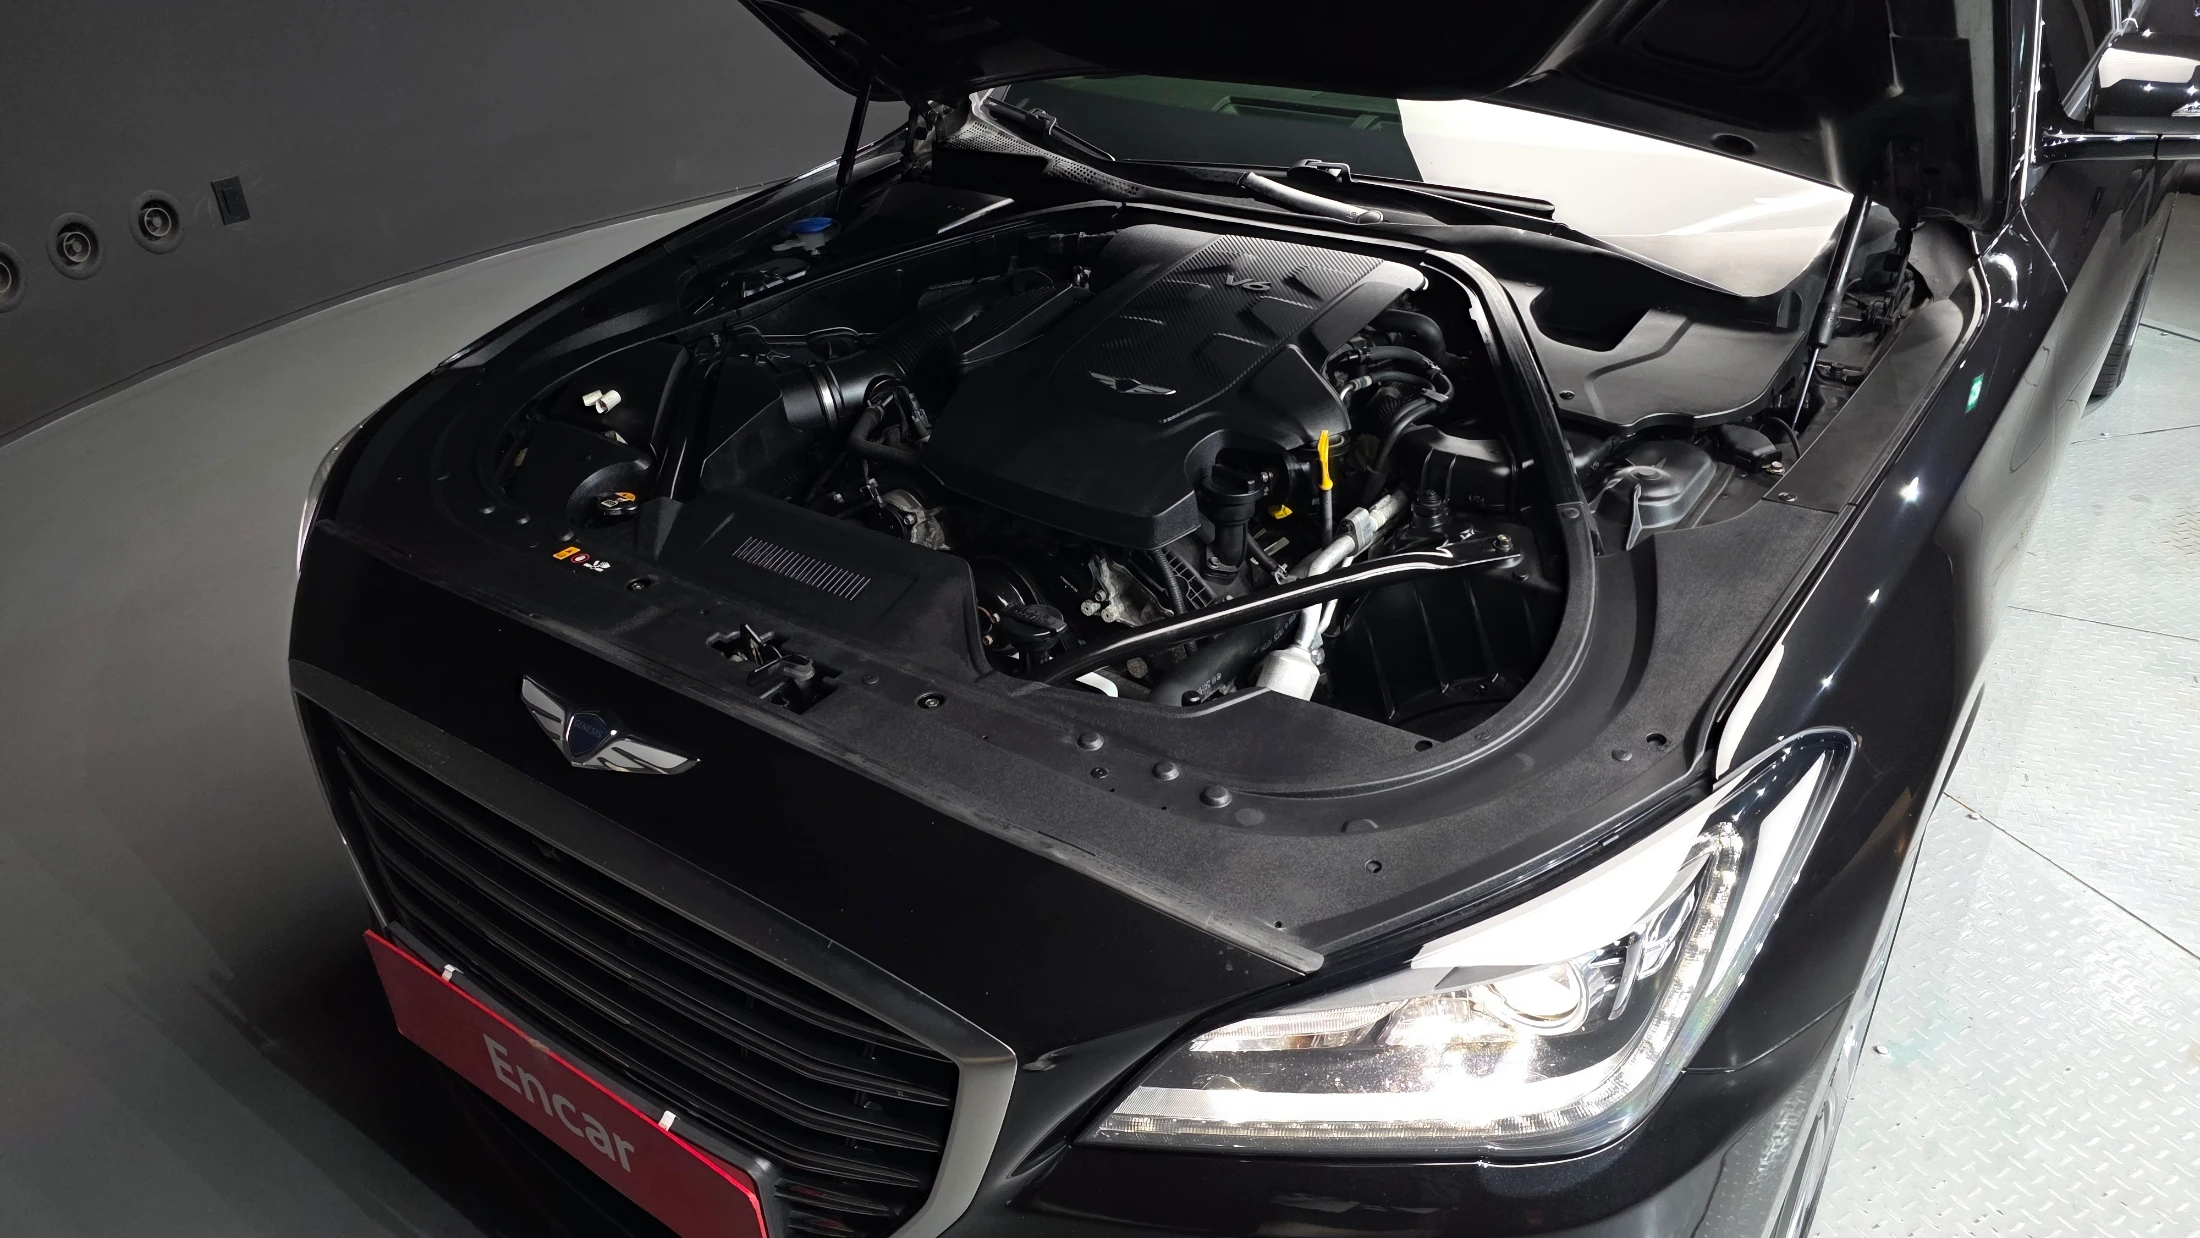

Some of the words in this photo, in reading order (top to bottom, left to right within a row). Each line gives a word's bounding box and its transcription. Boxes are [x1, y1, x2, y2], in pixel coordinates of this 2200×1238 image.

[1226, 274, 1271, 291] V6
[574, 720, 604, 739] GENESIS
[483, 1033, 634, 1173] Encar
